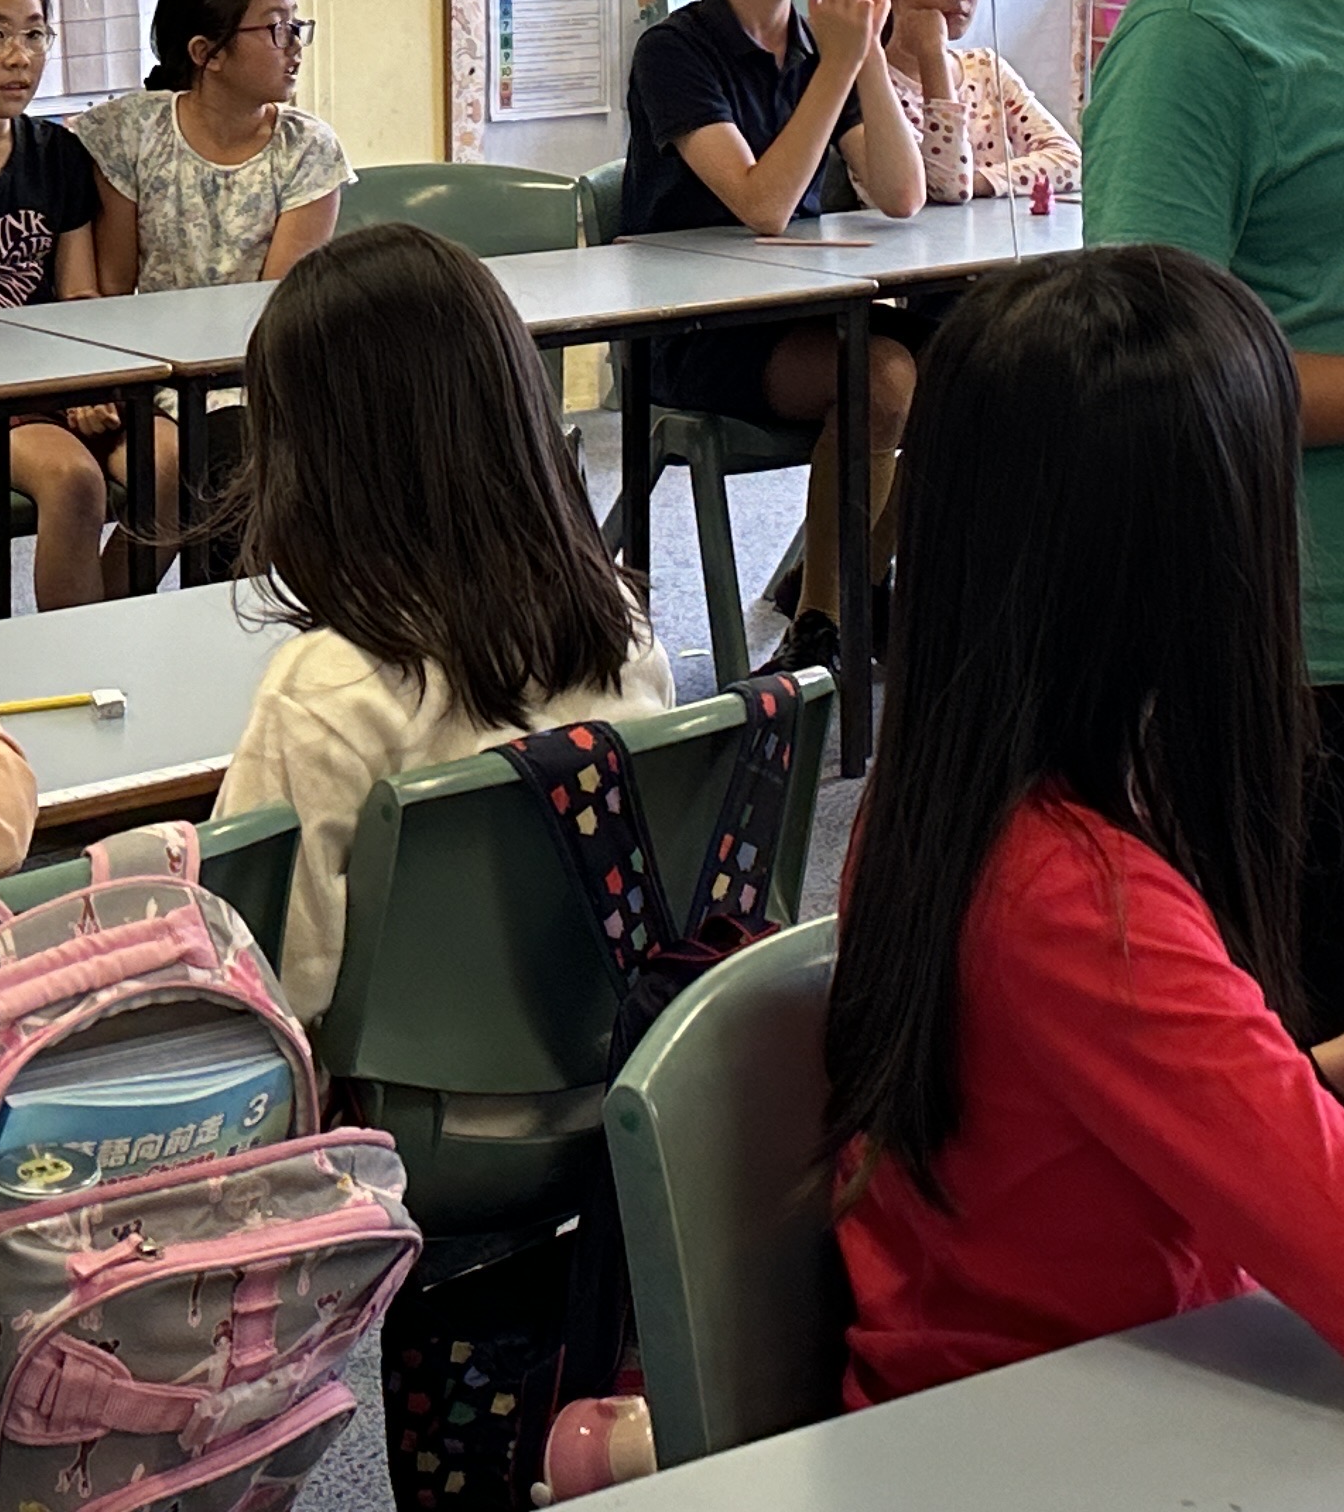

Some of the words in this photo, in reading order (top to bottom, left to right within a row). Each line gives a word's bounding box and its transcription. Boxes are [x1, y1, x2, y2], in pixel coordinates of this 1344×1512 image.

[62, 1112, 225, 1169] 語向前走
[243, 1092, 269, 1128] 3
